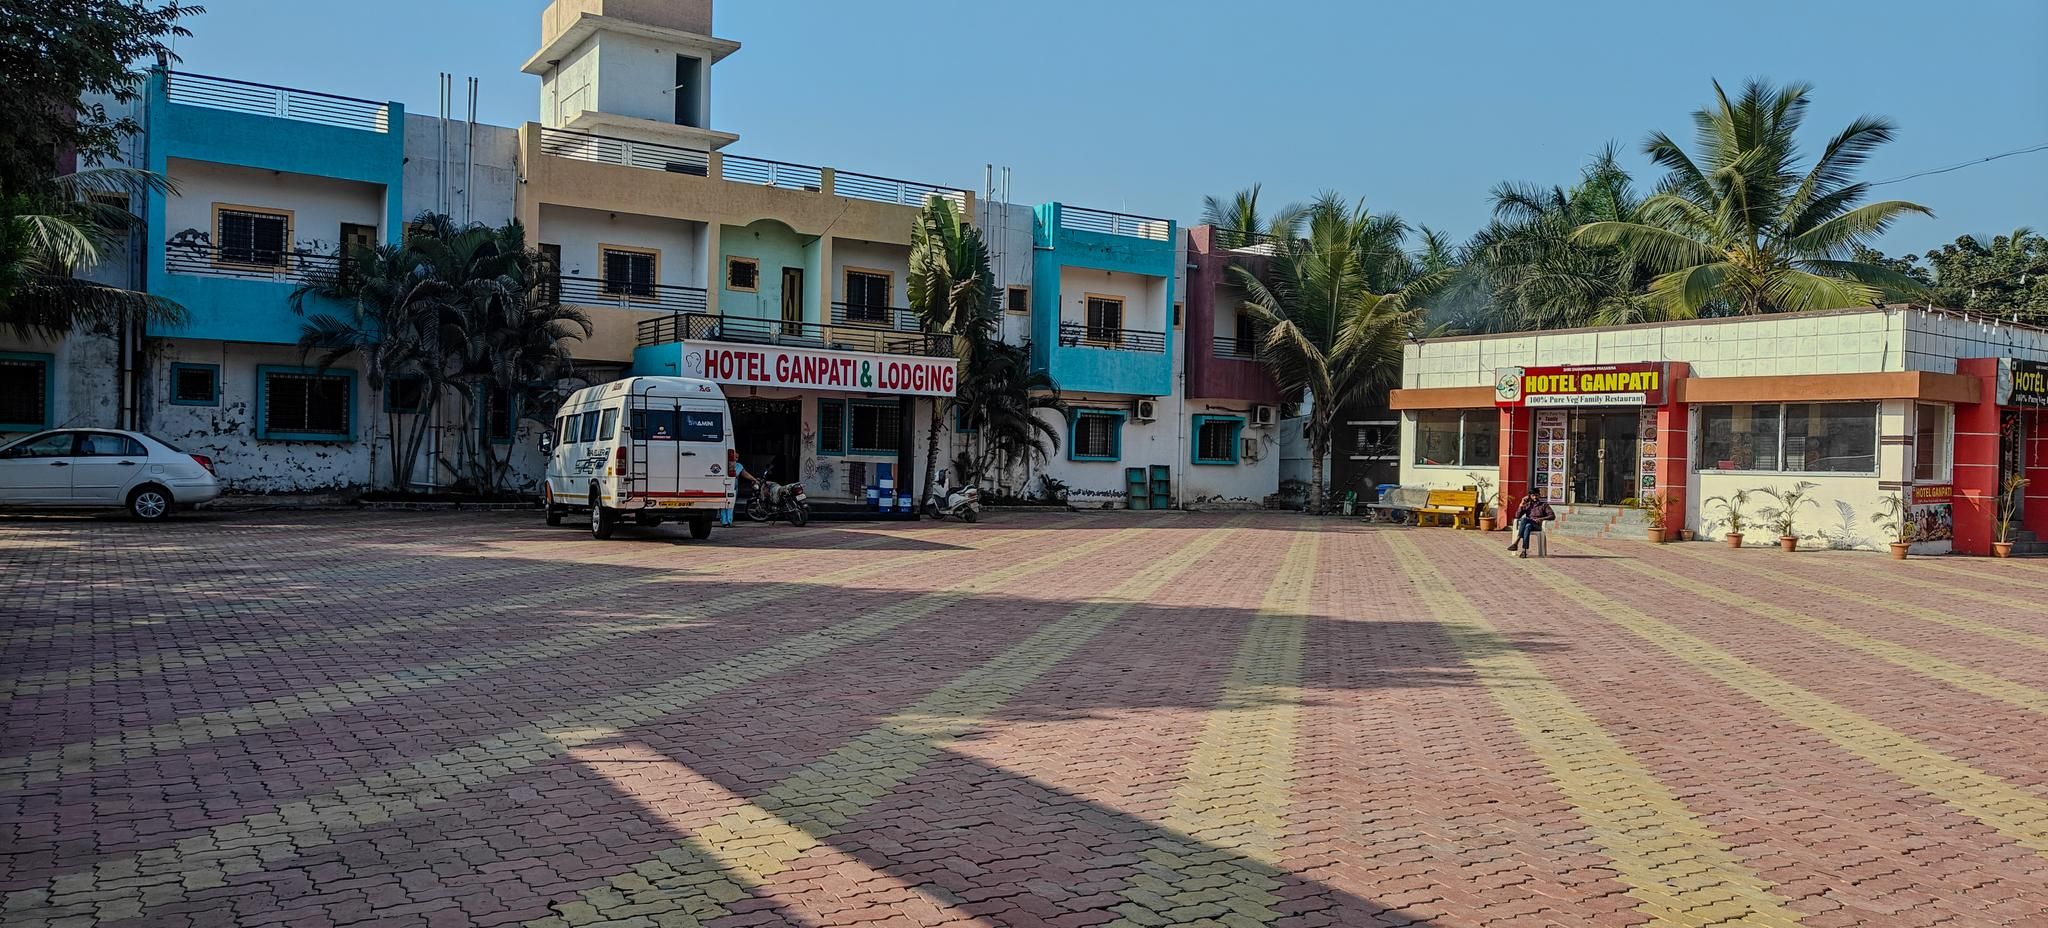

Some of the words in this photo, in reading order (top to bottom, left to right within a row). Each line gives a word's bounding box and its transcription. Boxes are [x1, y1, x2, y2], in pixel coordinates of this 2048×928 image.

[704, 349, 771, 382] HOTEL
[775, 353, 857, 387] GANPATI
[859, 359, 873, 388] &
[878, 361, 954, 393] LODGING
[1525, 374, 1577, 393] HOTEL
[1580, 371, 1659, 392] GANPATI
[2015, 371, 2046, 393] HOTEL
[1529, 396, 1548, 404] 100%
[1549, 396, 1565, 404] Pure
[1566, 395, 1579, 404] Veg
[1580, 395, 1602, 404] Family
[1605, 394, 1643, 403] Restaurant
[1915, 487, 1931, 497] HOTEL
